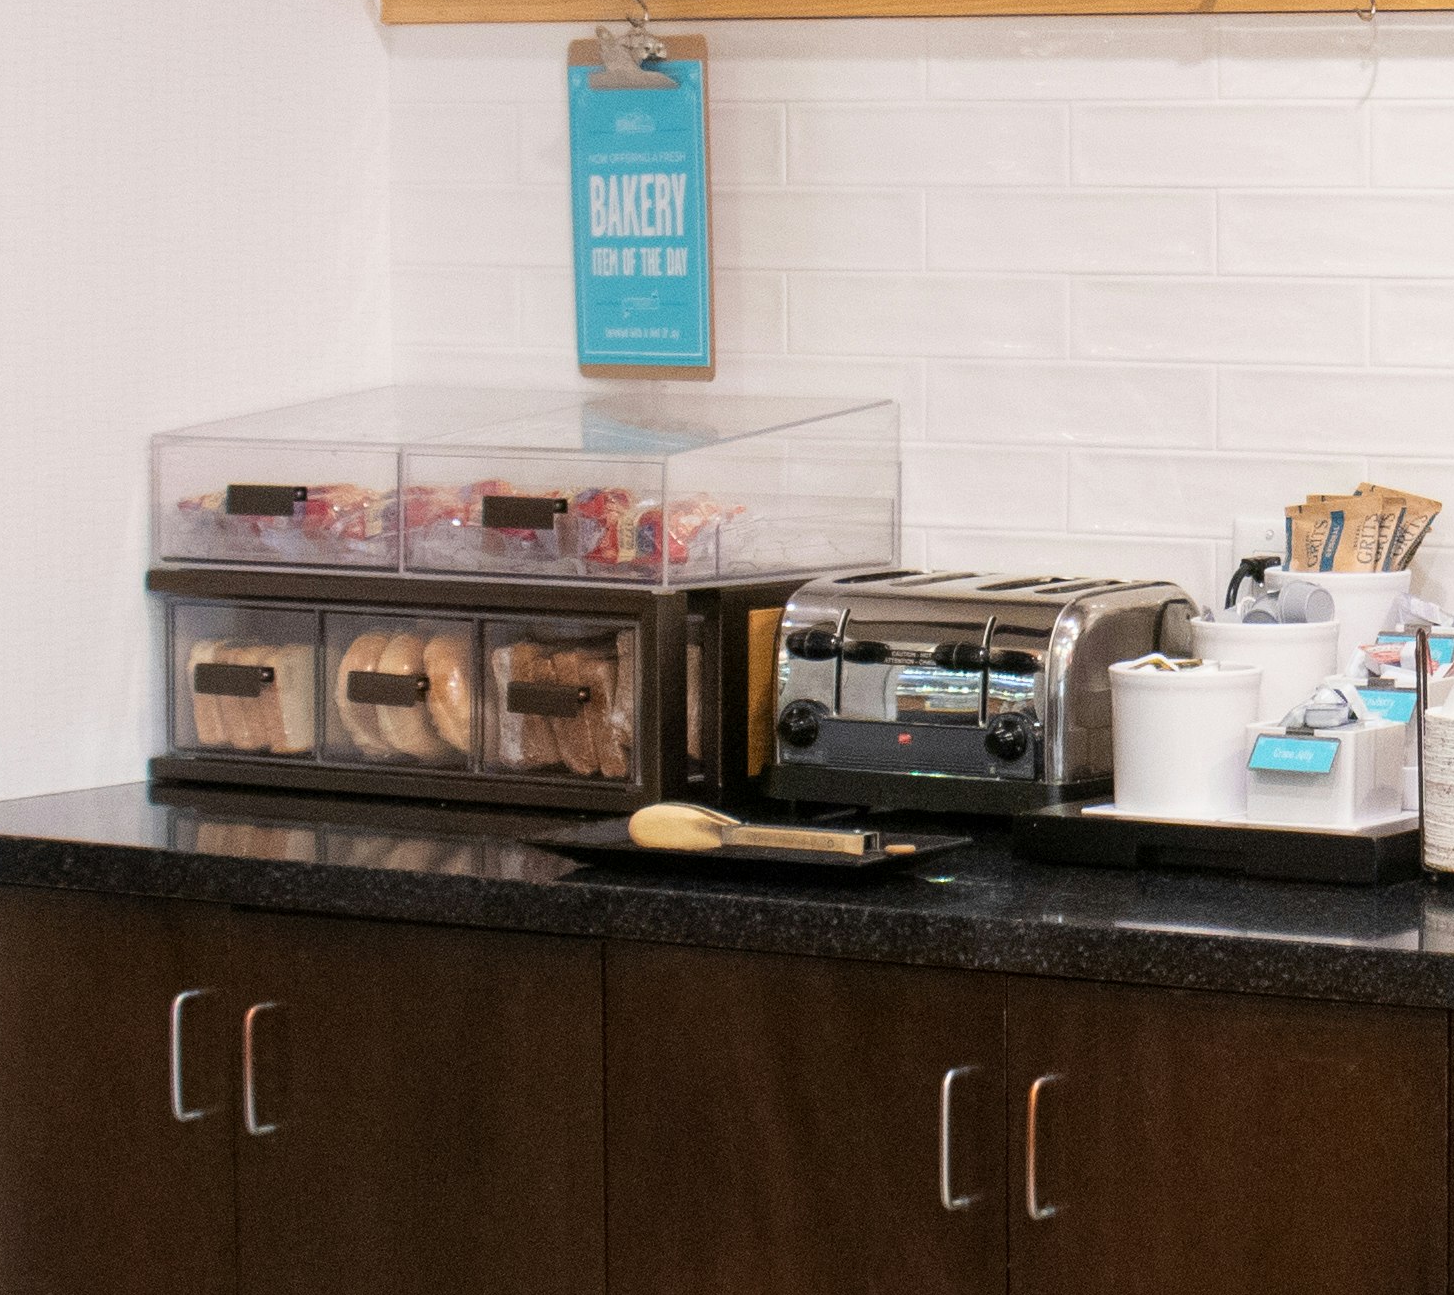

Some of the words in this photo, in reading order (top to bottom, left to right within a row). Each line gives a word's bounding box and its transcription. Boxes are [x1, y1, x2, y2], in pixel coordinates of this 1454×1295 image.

[589, 173, 687, 237] BAKERY
[592, 247, 618, 276] ITEM
[622, 247, 636, 276] OF
[640, 247, 662, 276] THE
[666, 247, 687, 276] DAY
[1306, 519, 1328, 567] GRITS
[1357, 513, 1379, 564] GRITS
